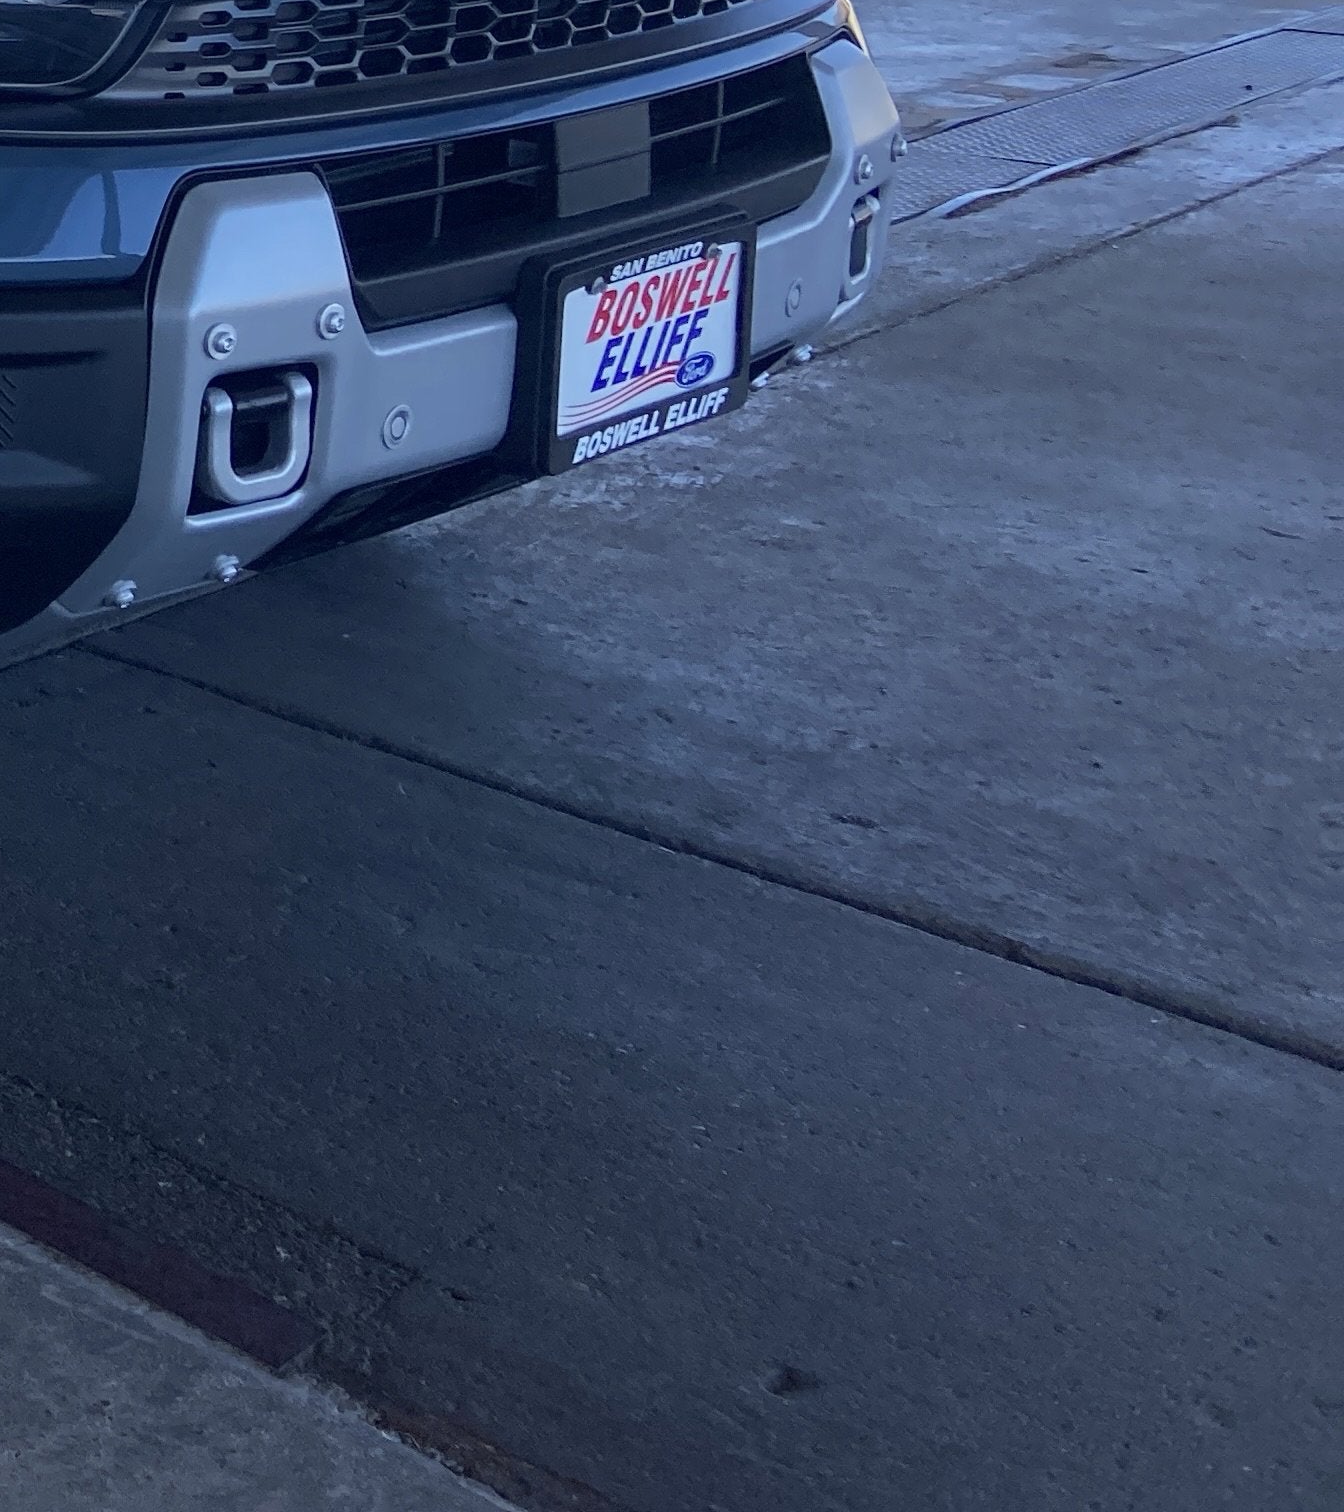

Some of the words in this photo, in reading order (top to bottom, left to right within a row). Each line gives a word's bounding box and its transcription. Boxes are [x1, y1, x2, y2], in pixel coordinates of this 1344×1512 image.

[585, 253, 737, 344] BOSWELL
[610, 258, 645, 281] SAN
[645, 241, 703, 271] BENITO
[591, 308, 710, 392] ELLIFF
[572, 410, 660, 464] BOSWELL
[663, 387, 729, 431] ELLIFF
